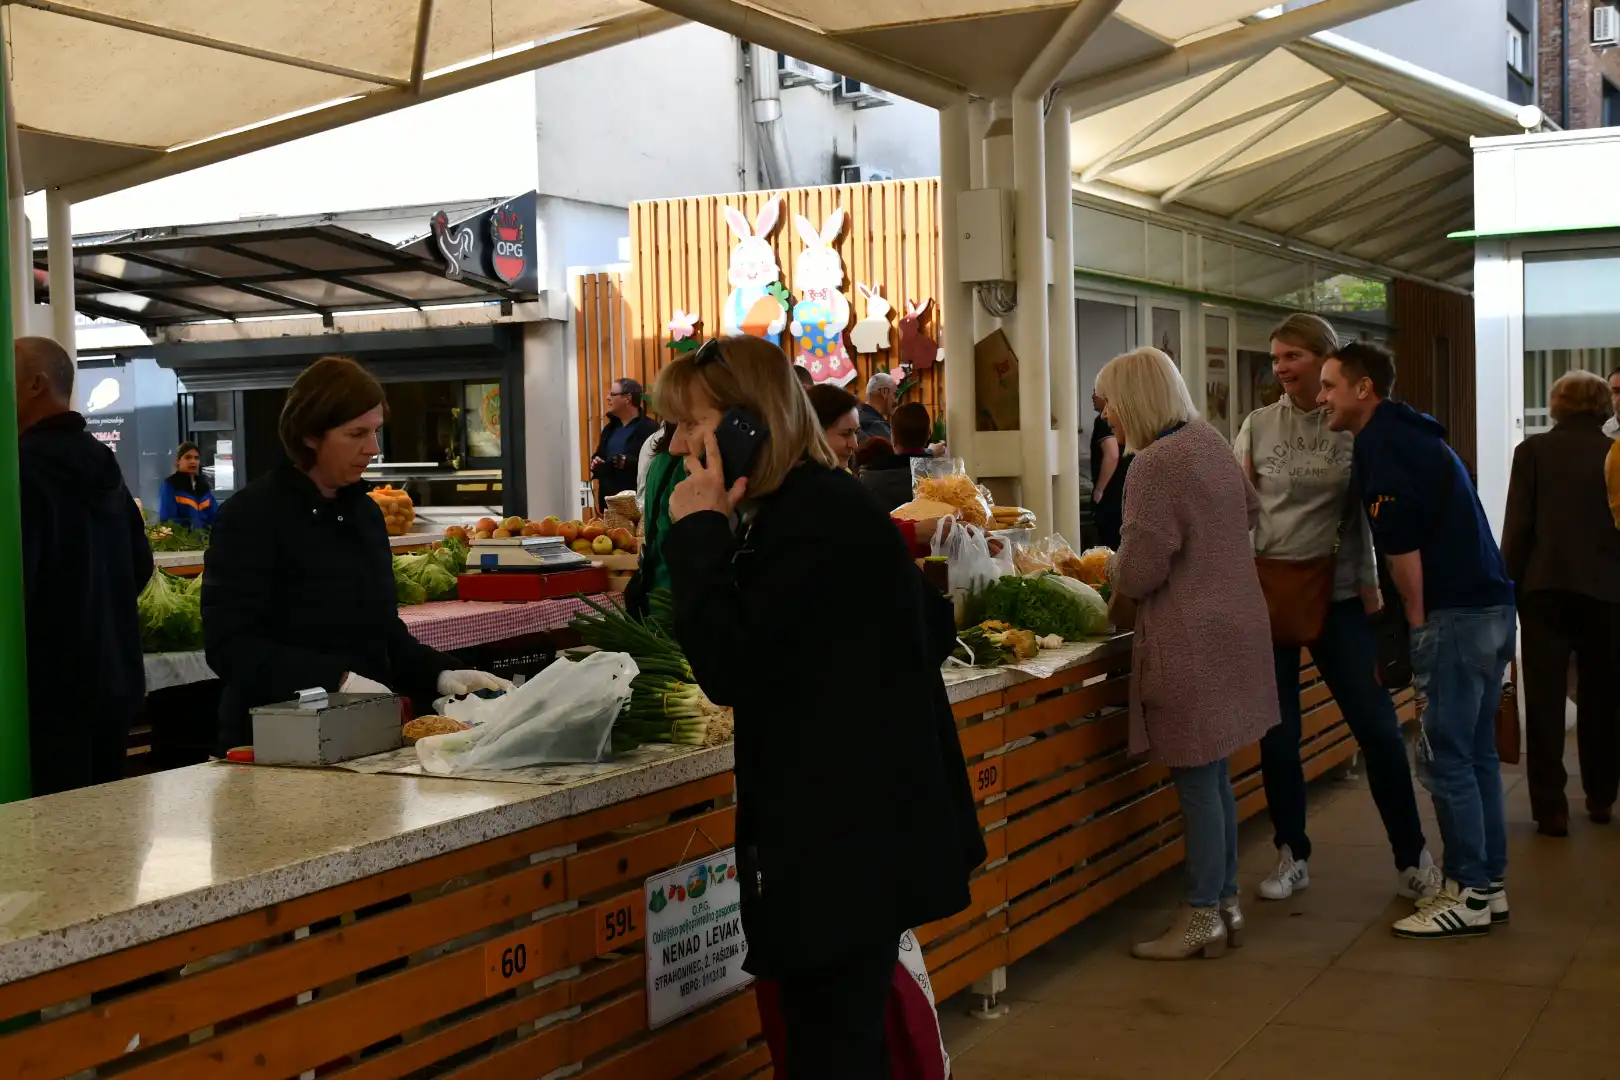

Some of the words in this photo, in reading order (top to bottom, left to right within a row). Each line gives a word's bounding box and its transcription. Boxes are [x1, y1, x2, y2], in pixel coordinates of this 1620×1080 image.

[496, 241, 523, 257] OPG
[1266, 440, 1296, 474] JACK
[1297, 436, 1306, 451] &
[978, 765, 998, 791] 59D
[605, 905, 637, 941] 59L
[691, 900, 711, 916] O.P.G.
[662, 933, 700, 967] NENAD
[705, 917, 740, 948] LEVAK
[712, 942, 739, 965] FAŠIZMA
[501, 943, 527, 979] 60
